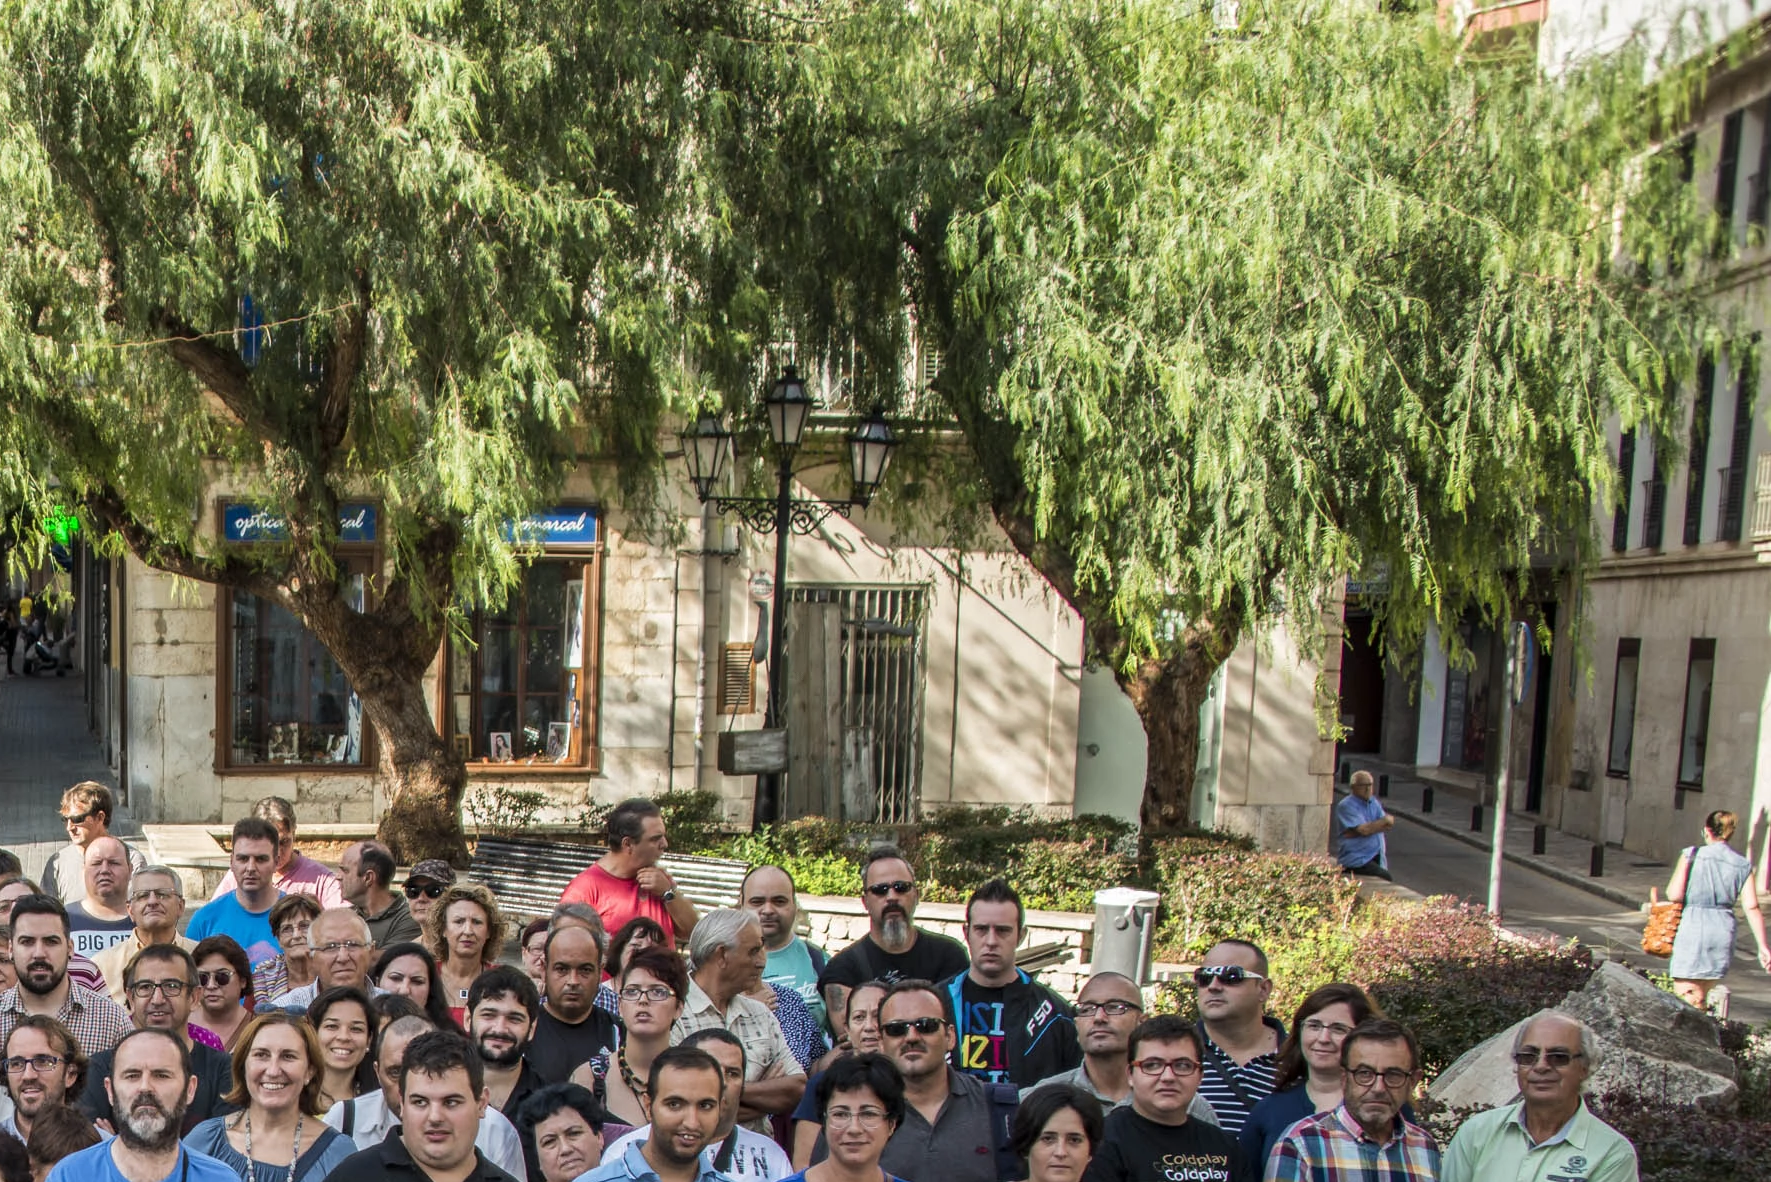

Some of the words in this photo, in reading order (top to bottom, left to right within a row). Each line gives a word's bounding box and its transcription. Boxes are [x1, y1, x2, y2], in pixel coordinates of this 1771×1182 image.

[78, 934, 104, 951] BIG
[1162, 1153, 1228, 1167] Coldplay
[1165, 1167, 1229, 1182] Coldplay
